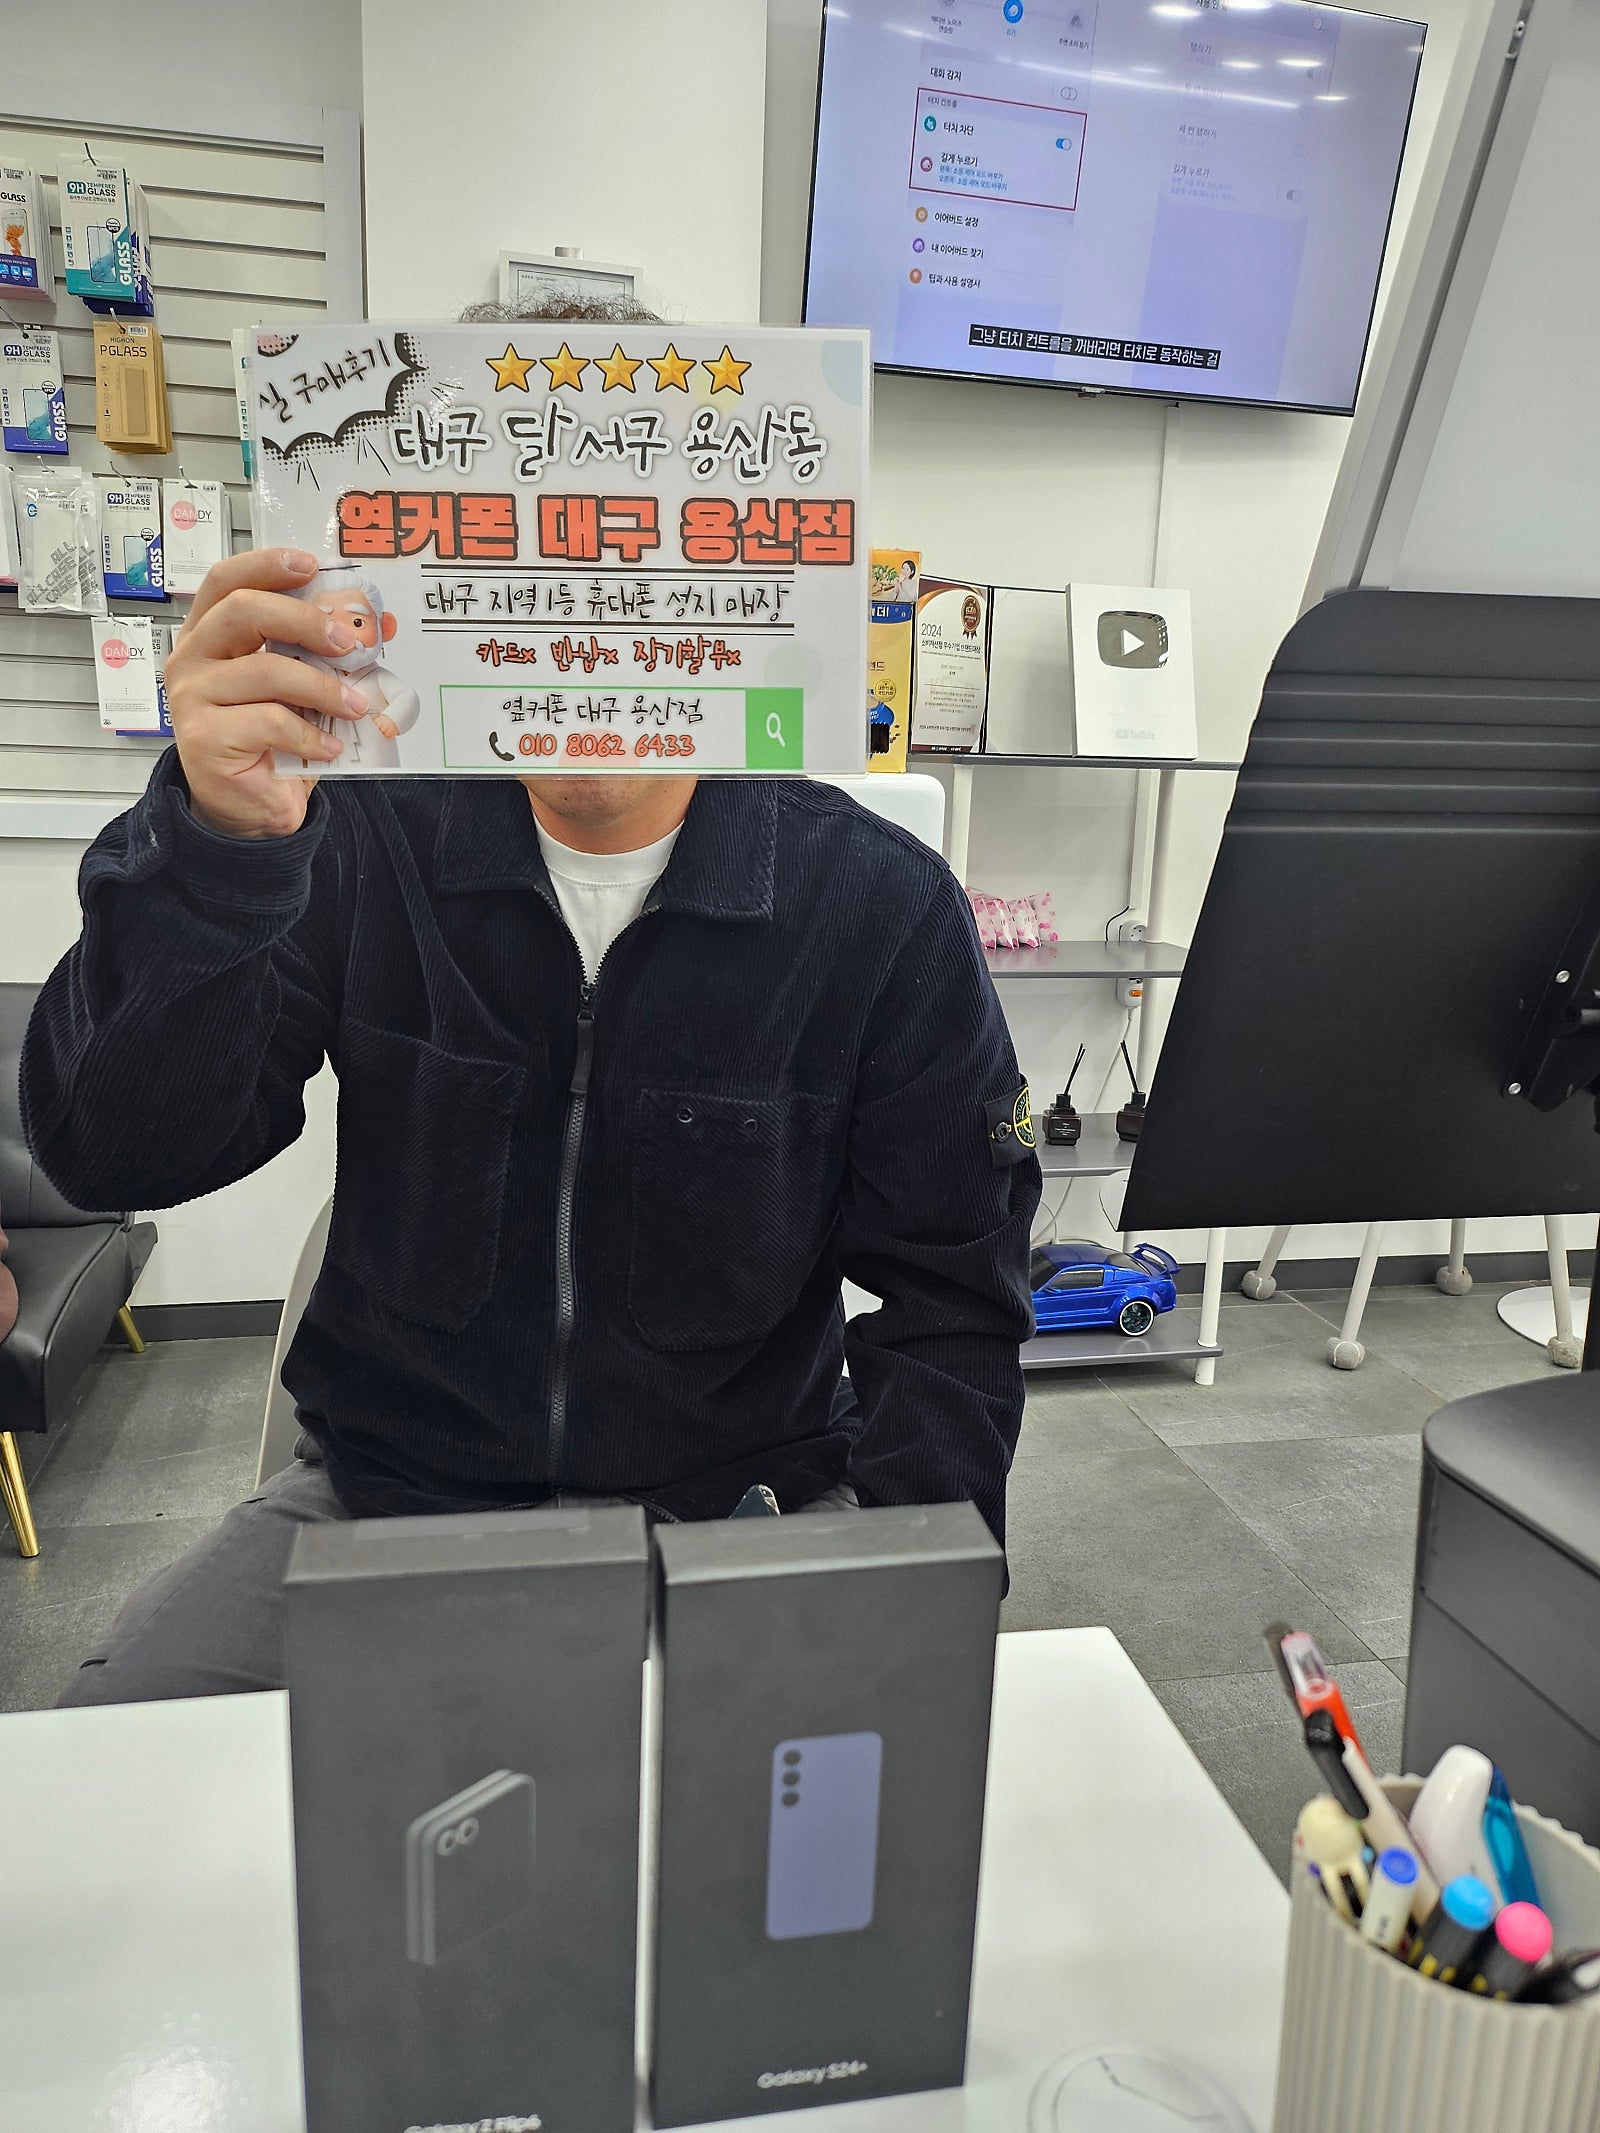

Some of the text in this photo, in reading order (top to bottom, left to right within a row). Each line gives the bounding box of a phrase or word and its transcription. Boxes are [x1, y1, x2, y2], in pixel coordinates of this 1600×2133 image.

[930, 67, 962, 82] 대화 감지
[943, 121, 974, 136] 터치 차단
[956, 154, 978, 167] 누르기
[68, 182, 86, 194] 9H
[87, 188, 116, 197] GLASS
[934, 212, 979, 228] 이어버드 설정
[931, 243, 984, 258] 내 이어버드 찾기
[117, 241, 133, 286] GLASS
[944, 276, 958, 287] 사용
[959, 278, 981, 289] 설명서
[4, 345, 22, 356] 9H
[23, 350, 51, 358] GLASS
[971, 327, 1219, 368] 그냥 터치 컨트롤을 꺼버리면 터치로 동작하는 걸
[259, 337, 391, 423] 실 구매후기
[52, 401, 67, 442] GLASS
[392, 406, 490, 470] 대구
[685, 410, 822, 478] 용산동
[107, 493, 123, 504] 9H
[174, 508, 212, 520] DANDY
[337, 490, 855, 566] 옆커폰 대구 용산점
[150, 547, 164, 587] GLASS
[425, 580, 790, 622] 대구 지역 1등 휴대폰 성지 매장
[921, 623, 942, 637] 2024
[105, 647, 144, 657] DANDY
[502, 693, 704, 725] 옆커폰 대구 용산점
[518, 733, 696, 757] 010 8062 6433
[757, 2067, 825, 2089] Galaxy
